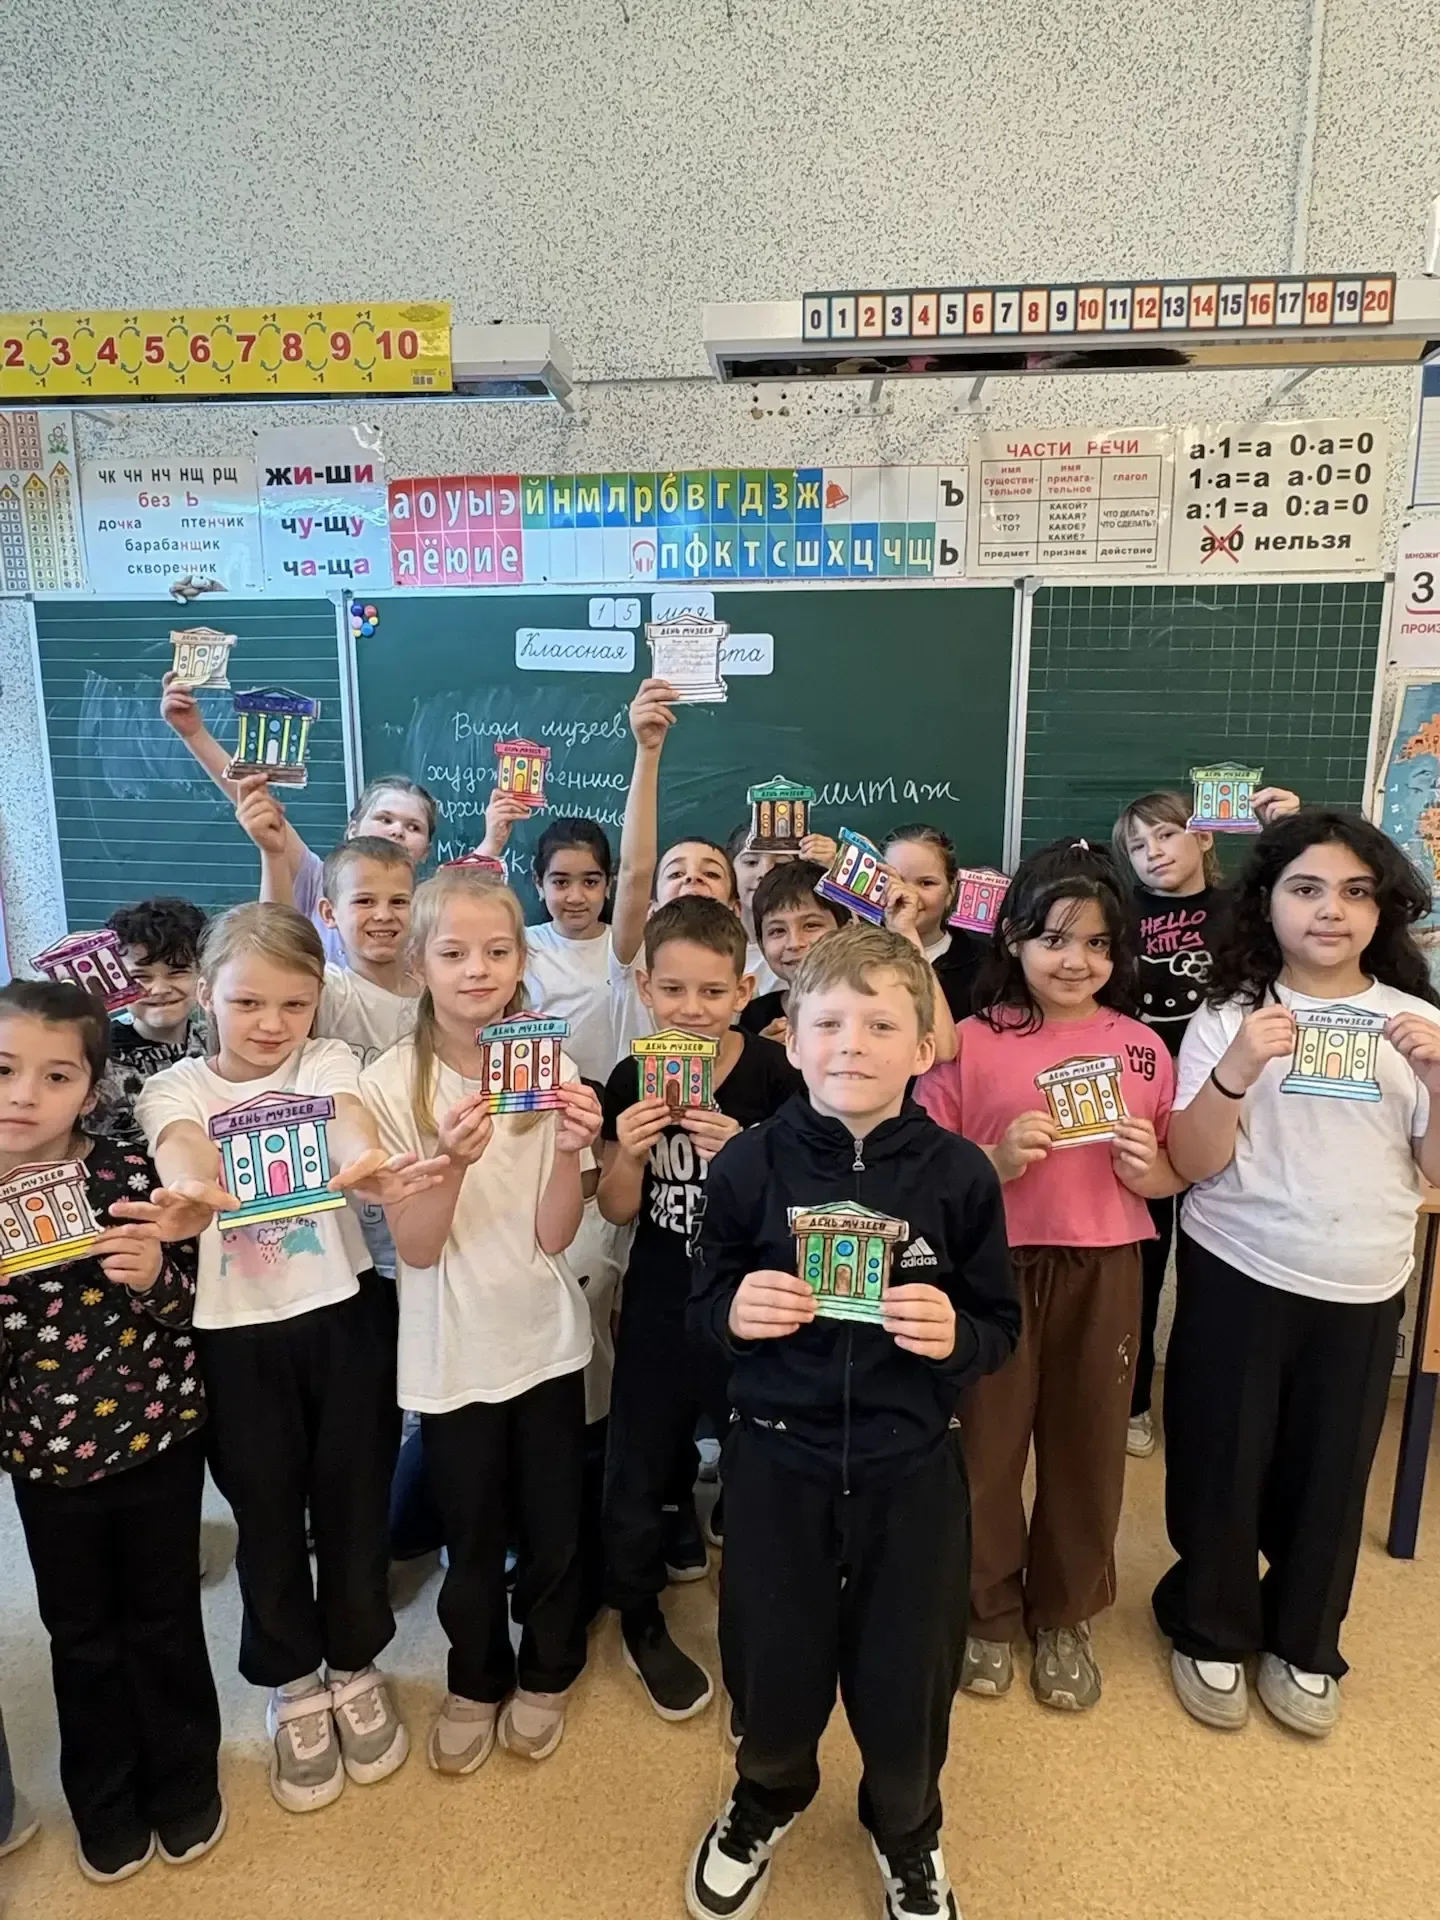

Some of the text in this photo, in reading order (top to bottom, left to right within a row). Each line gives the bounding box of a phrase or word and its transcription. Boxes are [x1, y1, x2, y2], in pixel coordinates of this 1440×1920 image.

[811, 290, 1388, 329] 0 1 2 3 4 5 6 7 8 9 10 11 12 13 14 15 16 17 18 19 20
[30, 310, 371, 327] +1 +1 +1 +1 +1 +1 +1 +1
[4, 330, 418, 367] 2 3 4 5 6 7 8 9 10
[35, 372, 372, 387] -1 -1 -1 -1 -1 -1 -1 -1
[1007, 440, 1139, 457] ЧАСТИ РЕЧИ
[265, 464, 374, 486] жи-ши
[1001, 466, 1021, 474] имя
[1061, 464, 1081, 472] имя
[98, 468, 237, 484] чк чн нч нщ рщ
[1047, 475, 1094, 484] прилага-
[1113, 473, 1147, 481] глагол
[989, 488, 1032, 496] тельное
[1048, 486, 1092, 494] тельное
[138, 492, 171, 508] без
[996, 513, 1020, 521] КТО?
[1049, 513, 1087, 521] КАКАЯ?
[1120, 510, 1155, 518] ДЕЛАТЬ?
[98, 517, 244, 532] дочка птенчик
[281, 516, 364, 539] чу-щу
[1048, 523, 1086, 531] КАКОЕ?
[125, 539, 221, 553] барабанщик
[1254, 534, 1351, 551] нельзя
[984, 547, 1152, 559] предмет признак действие
[128, 563, 217, 576] скворечник
[283, 558, 370, 578] ча-ща
[1411, 571, 1434, 603] 3
[520, 631, 628, 659] Классная
[452, 709, 627, 747] Виды музеев
[1141, 909, 1207, 938] HELLO
[229, 1105, 314, 1128] ДЕНЬ МУЗЕЕВ
[21, 1170, 64, 1190] МУЗЕЕВ
[901, 1256, 938, 1268] adidas
